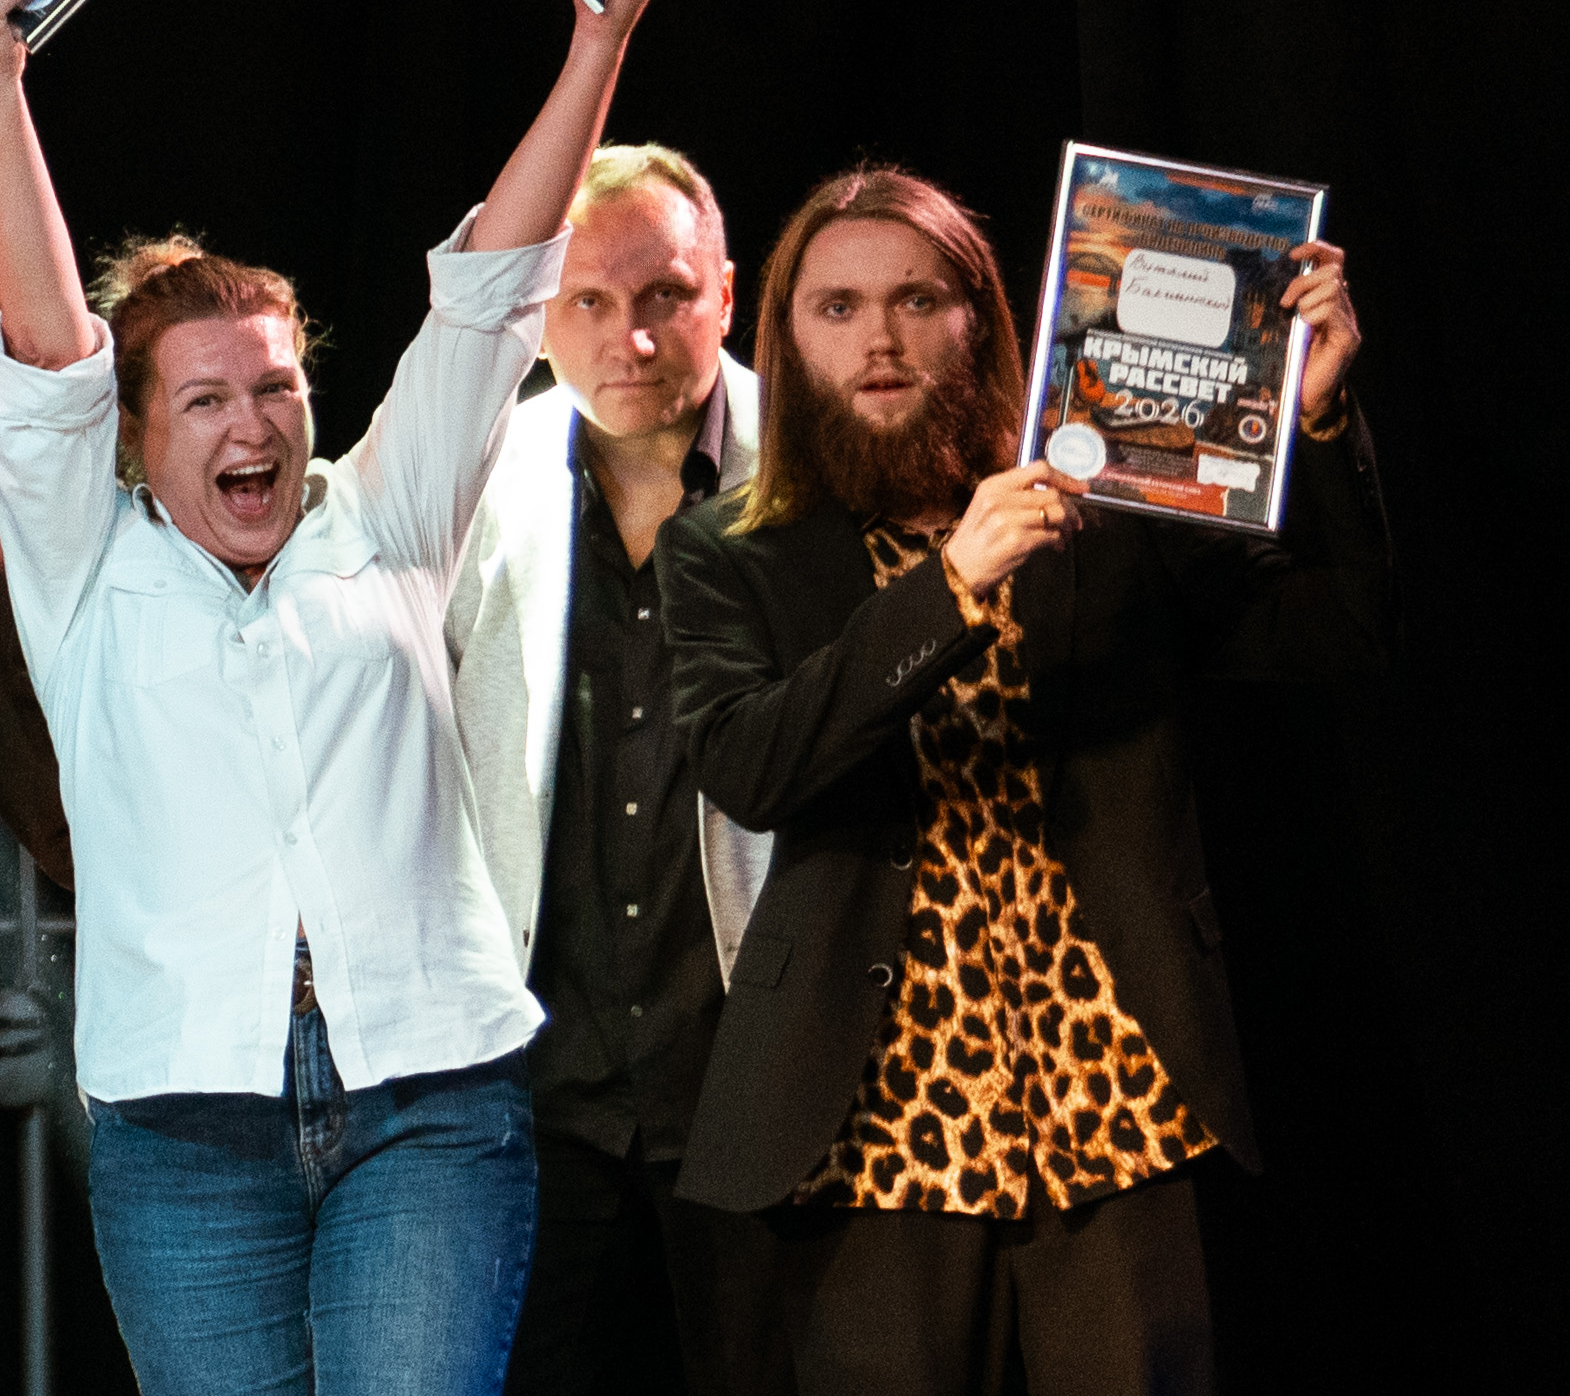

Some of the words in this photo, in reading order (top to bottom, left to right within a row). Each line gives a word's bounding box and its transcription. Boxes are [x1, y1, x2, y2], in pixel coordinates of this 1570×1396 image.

[1083, 336, 1248, 384] КРЫМСКИЙ
[1109, 362, 1232, 404] РАССВЕТ
[1114, 389, 1205, 429] 2026
